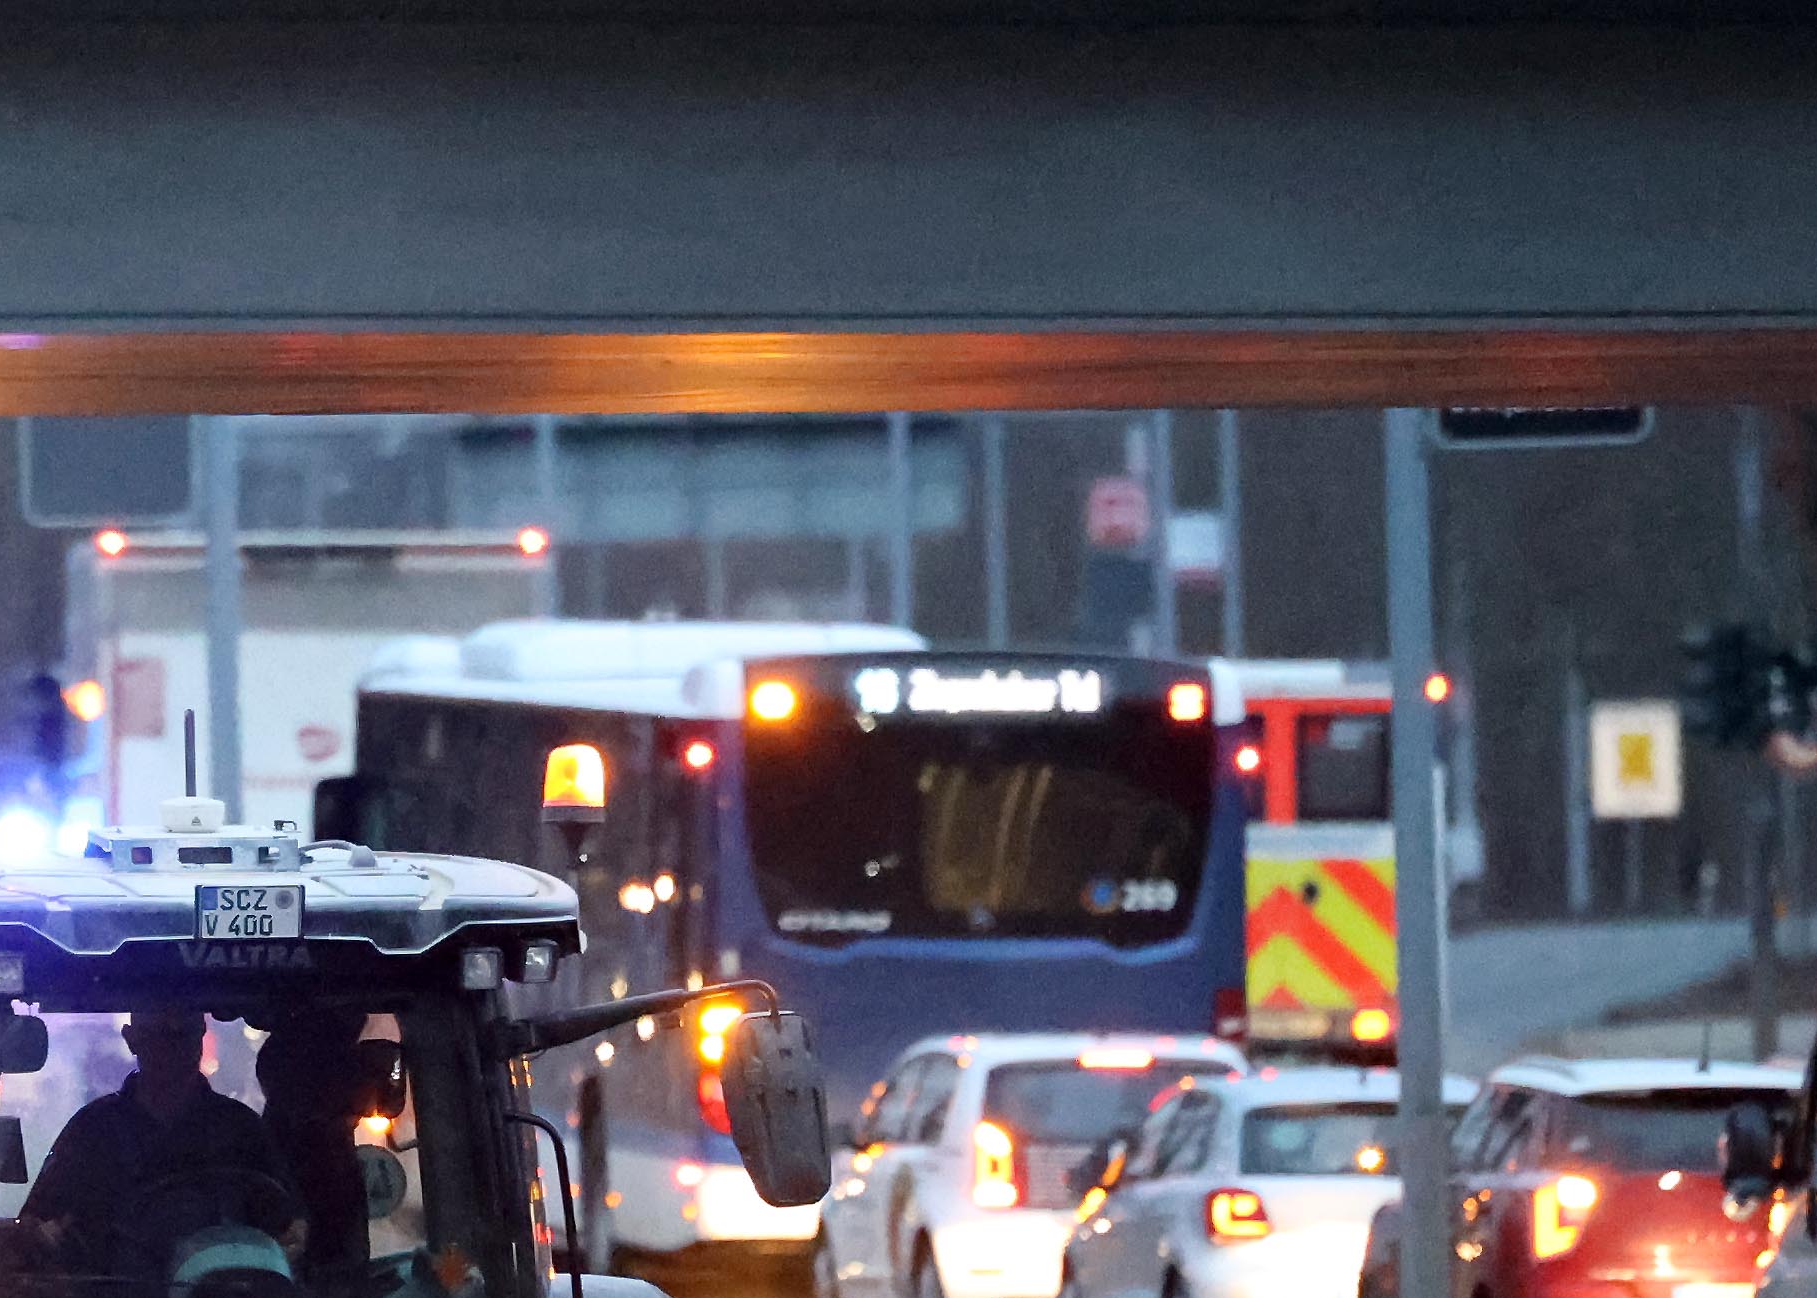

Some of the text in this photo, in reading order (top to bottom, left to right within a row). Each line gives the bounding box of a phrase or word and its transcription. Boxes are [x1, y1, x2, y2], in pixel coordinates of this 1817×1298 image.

[219, 889, 269, 911] SCZ
[205, 914, 274, 937] V 400
[178, 942, 312, 969] VALTRA
